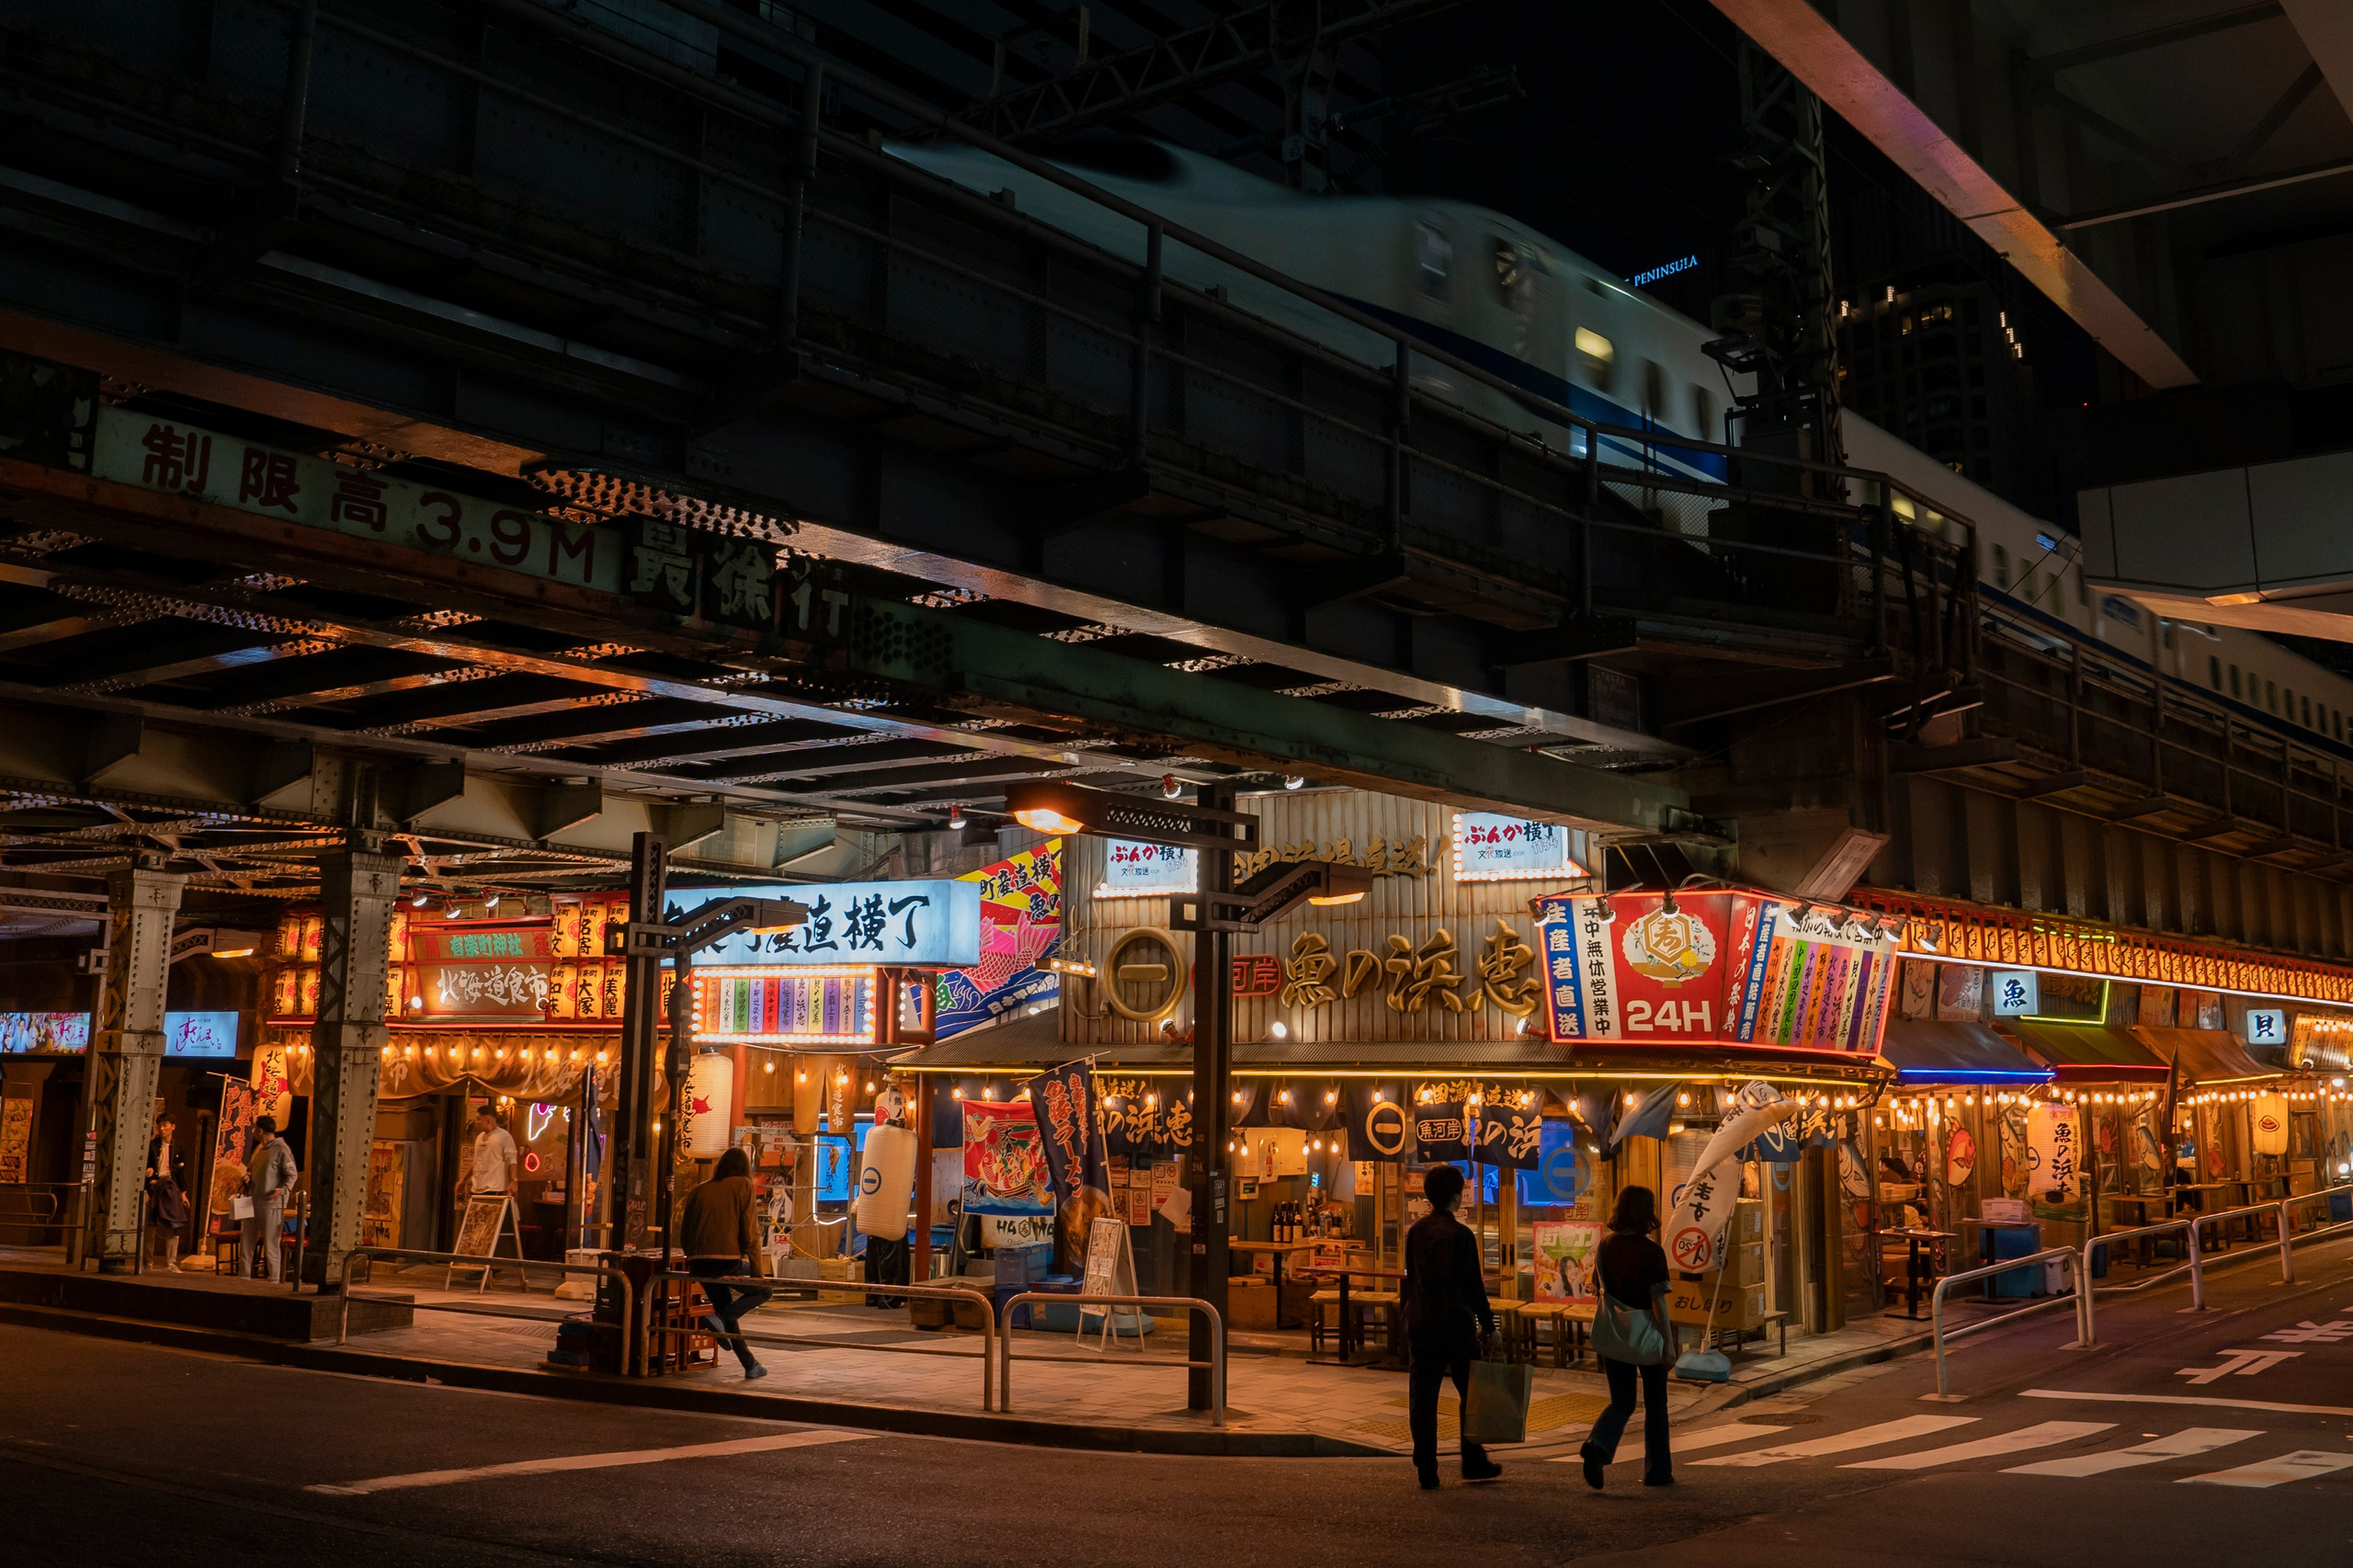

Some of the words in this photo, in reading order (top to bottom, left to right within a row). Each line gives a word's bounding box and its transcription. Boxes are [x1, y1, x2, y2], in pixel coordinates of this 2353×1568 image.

[1634, 255, 1698, 287] PENINSULA
[449, 932, 523, 958] 有楽町神社
[1280, 919, 1543, 1017] 魚の浜恵
[1547, 902, 1580, 1036] 生産者直送
[1582, 902, 1610, 1035] 年中無休営業中
[437, 965, 549, 1006] 北海道食市
[2004, 979, 2027, 1008] 魚
[1626, 1000, 1712, 1032] 24H
[2255, 1014, 2275, 1038] 貝
[263, 1050, 281, 1119] 北海道食
[1419, 1120, 1461, 1139] 魚河岸
[1675, 1295, 1733, 1313] おしぼり
